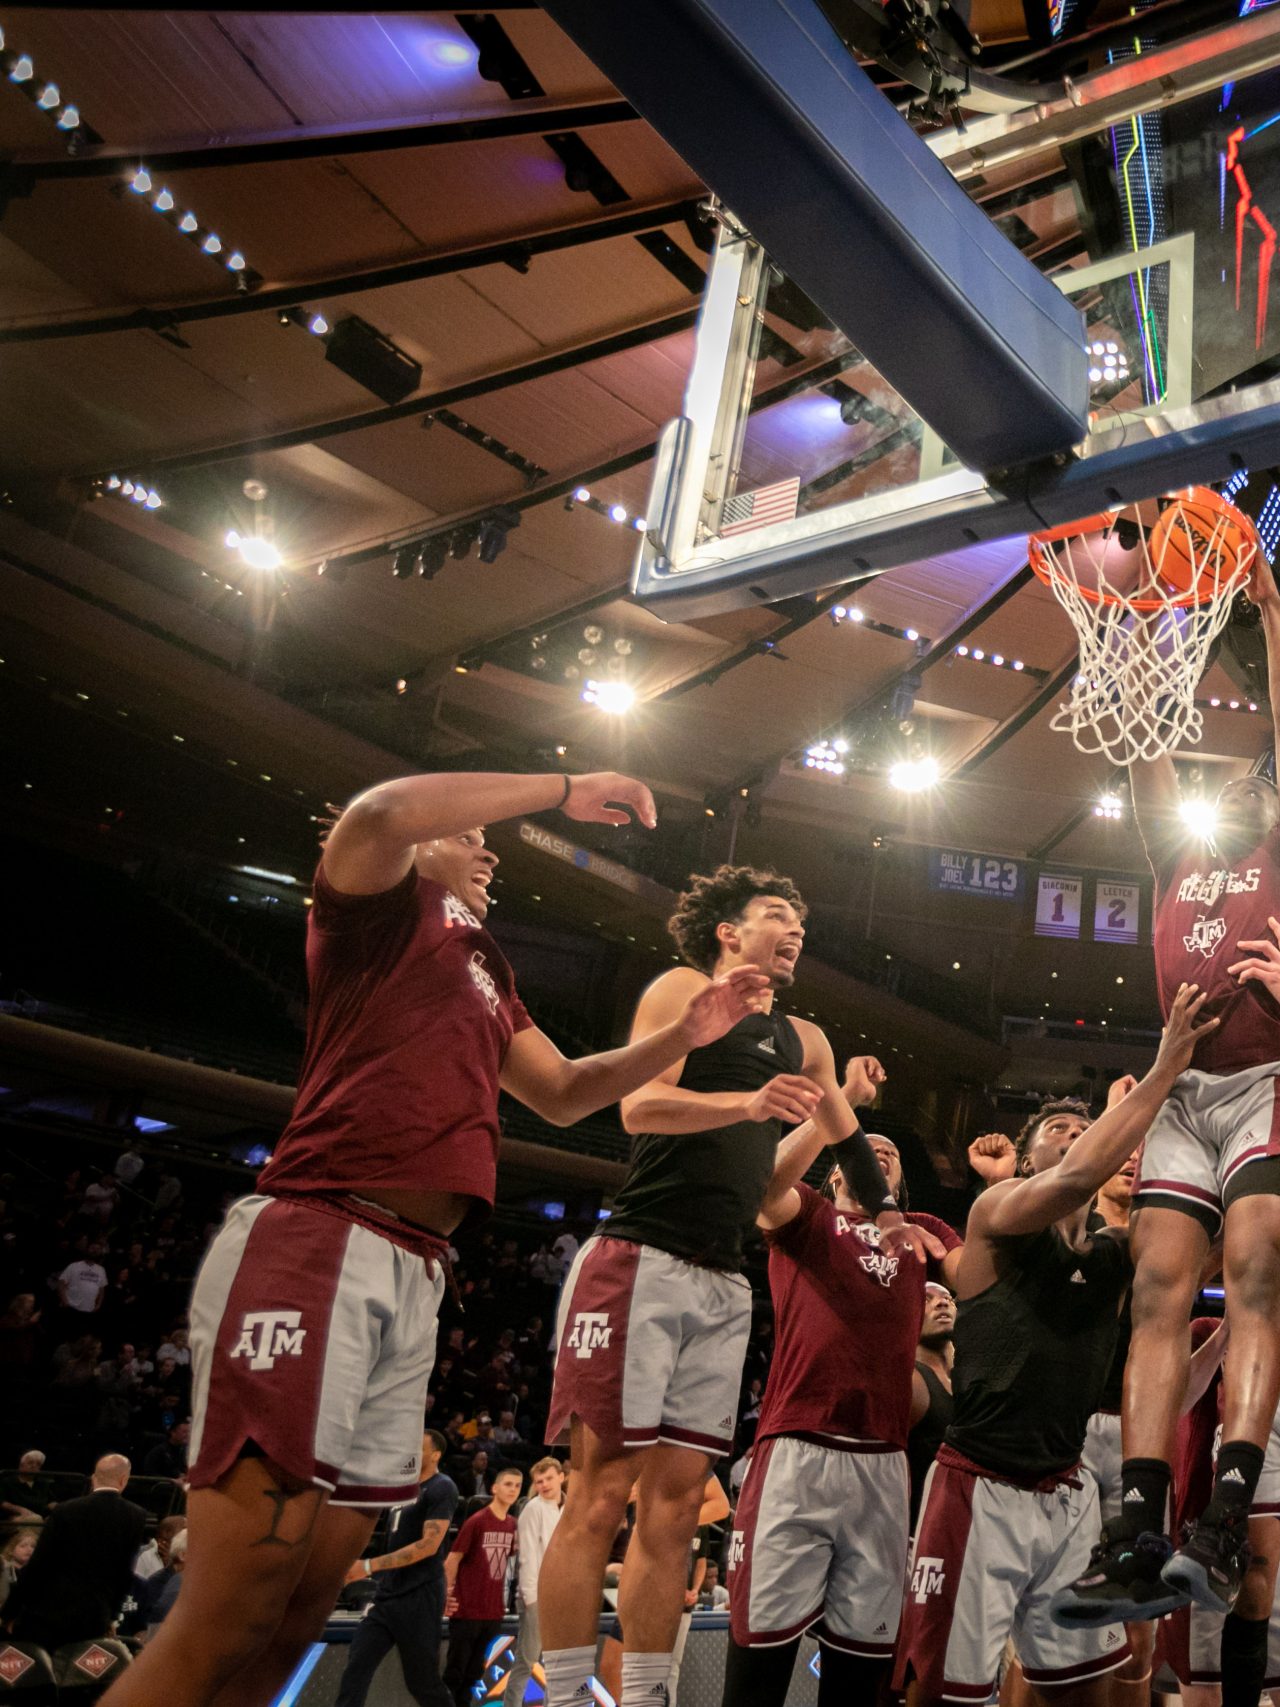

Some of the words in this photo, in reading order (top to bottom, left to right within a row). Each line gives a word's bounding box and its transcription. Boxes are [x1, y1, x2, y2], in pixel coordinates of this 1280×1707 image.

[520, 824, 573, 858] CHASE
[941, 853, 969, 870] BILLY
[941, 868, 964, 884] JOEL
[969, 857, 1018, 892] 123
[1103, 887, 1132, 898] LEETCH
[1051, 893, 1065, 922] 1
[1107, 899, 1126, 928] 2
[86, 1656, 108, 1667] NIT
